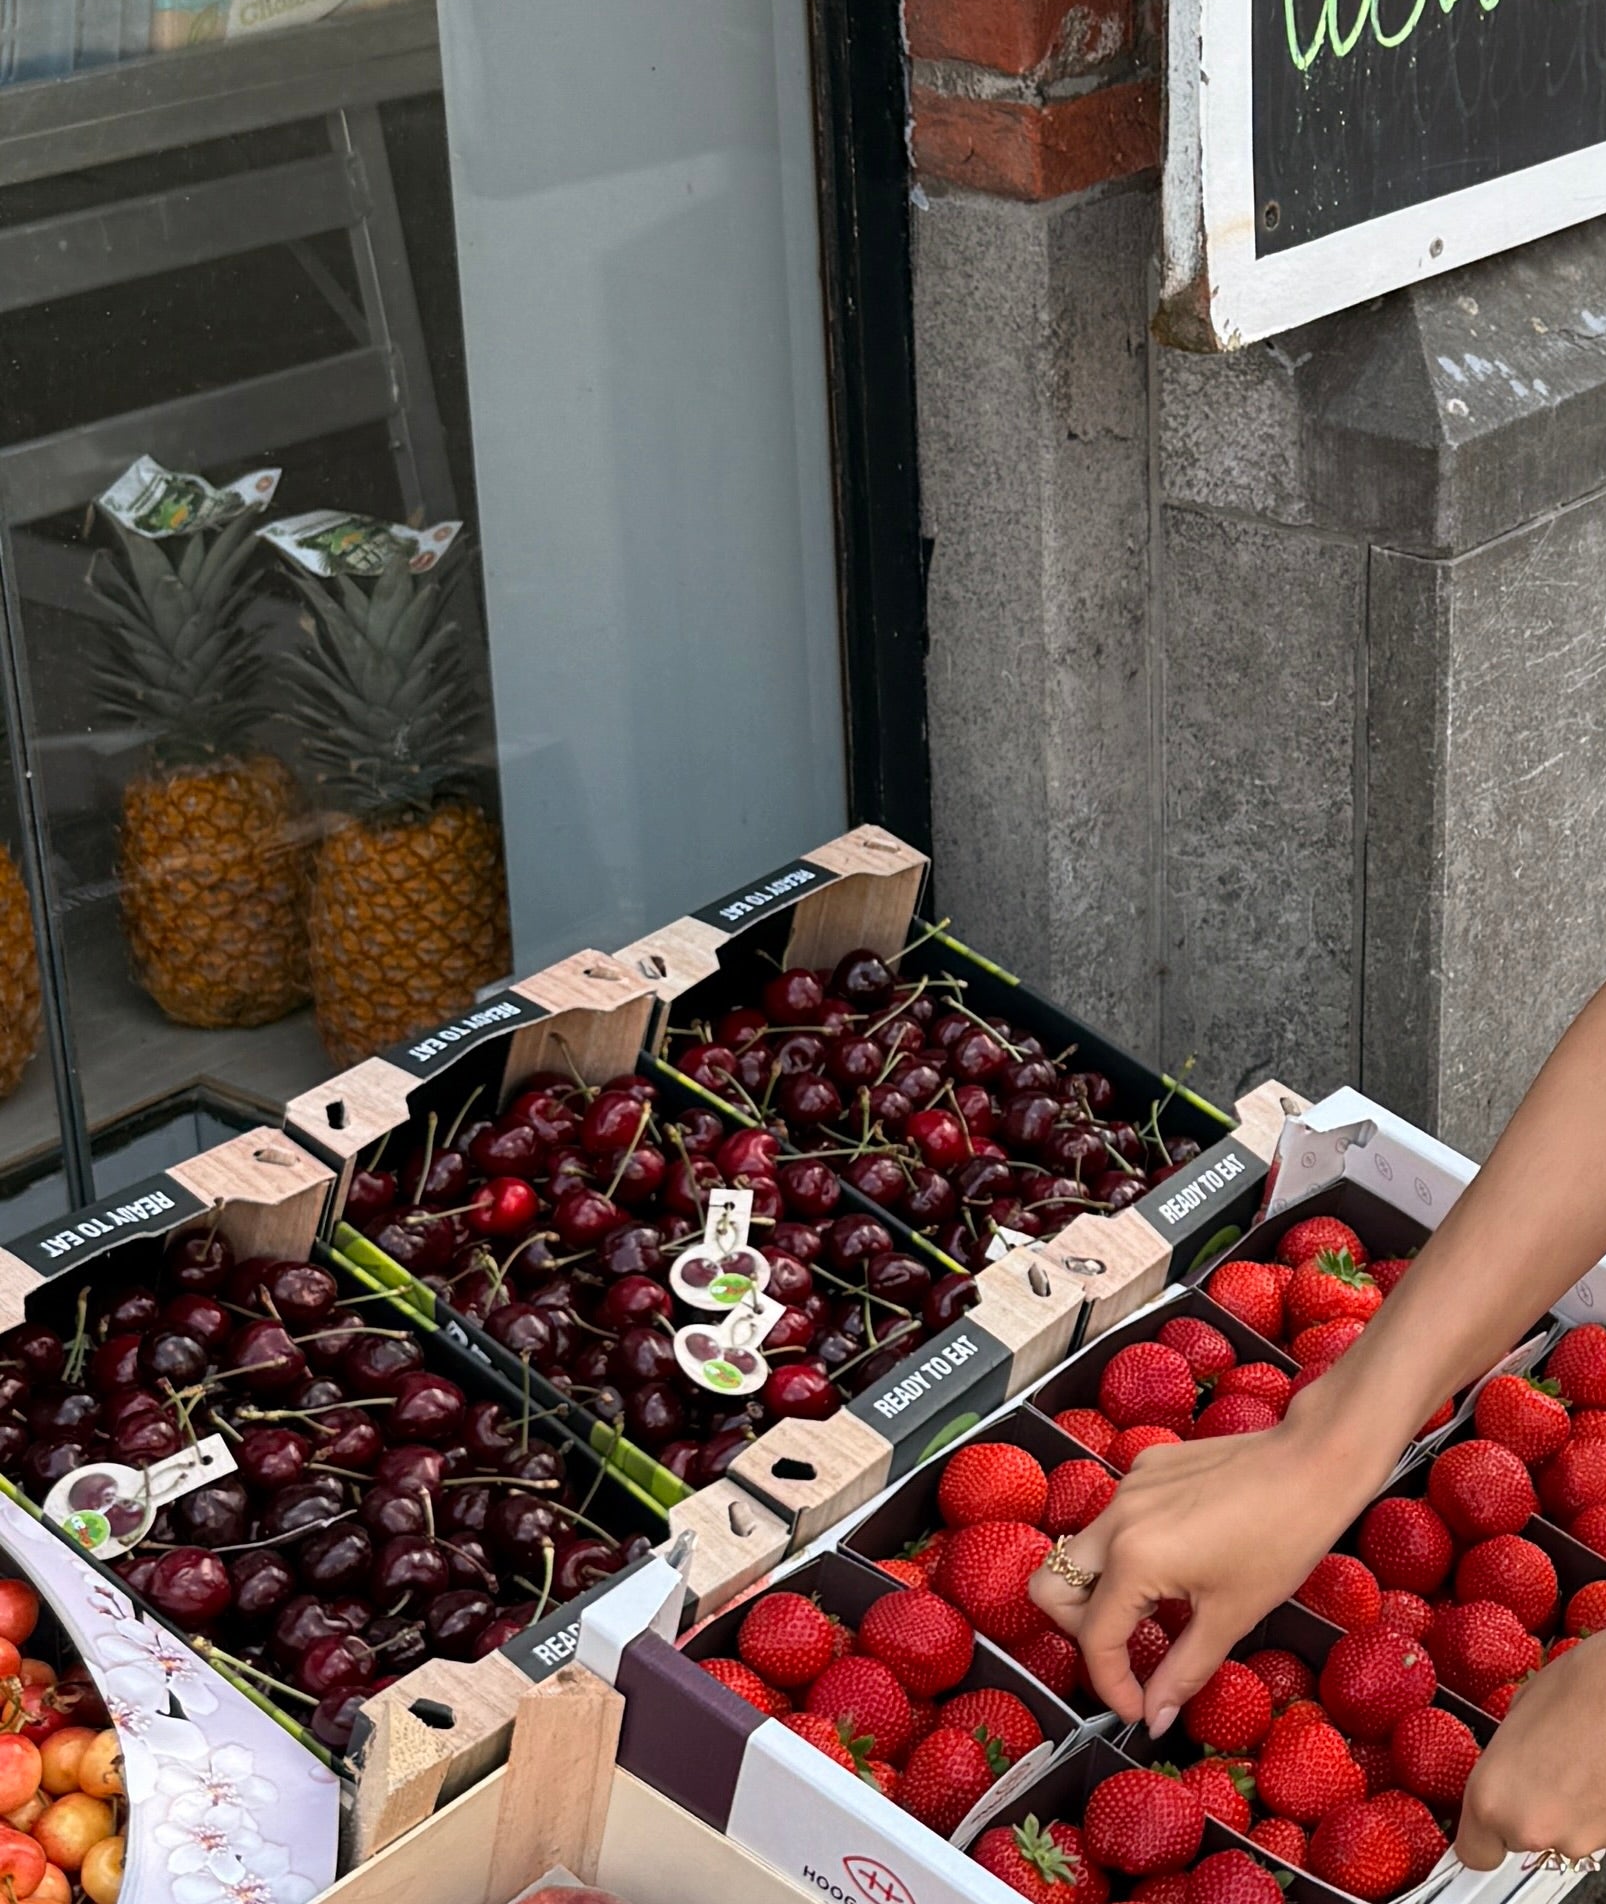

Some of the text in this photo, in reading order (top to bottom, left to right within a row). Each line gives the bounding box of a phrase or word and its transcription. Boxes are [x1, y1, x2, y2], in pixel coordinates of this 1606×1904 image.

[744, 891, 774, 906] TO
[408, 1002, 522, 1062] READY TO EAT
[1159, 1153, 1246, 1225] READY TO EAT
[40, 1190, 176, 1258] READY TO EAT
[873, 1335, 979, 1419] READY TO EAT
[532, 1620, 581, 1666] REA
